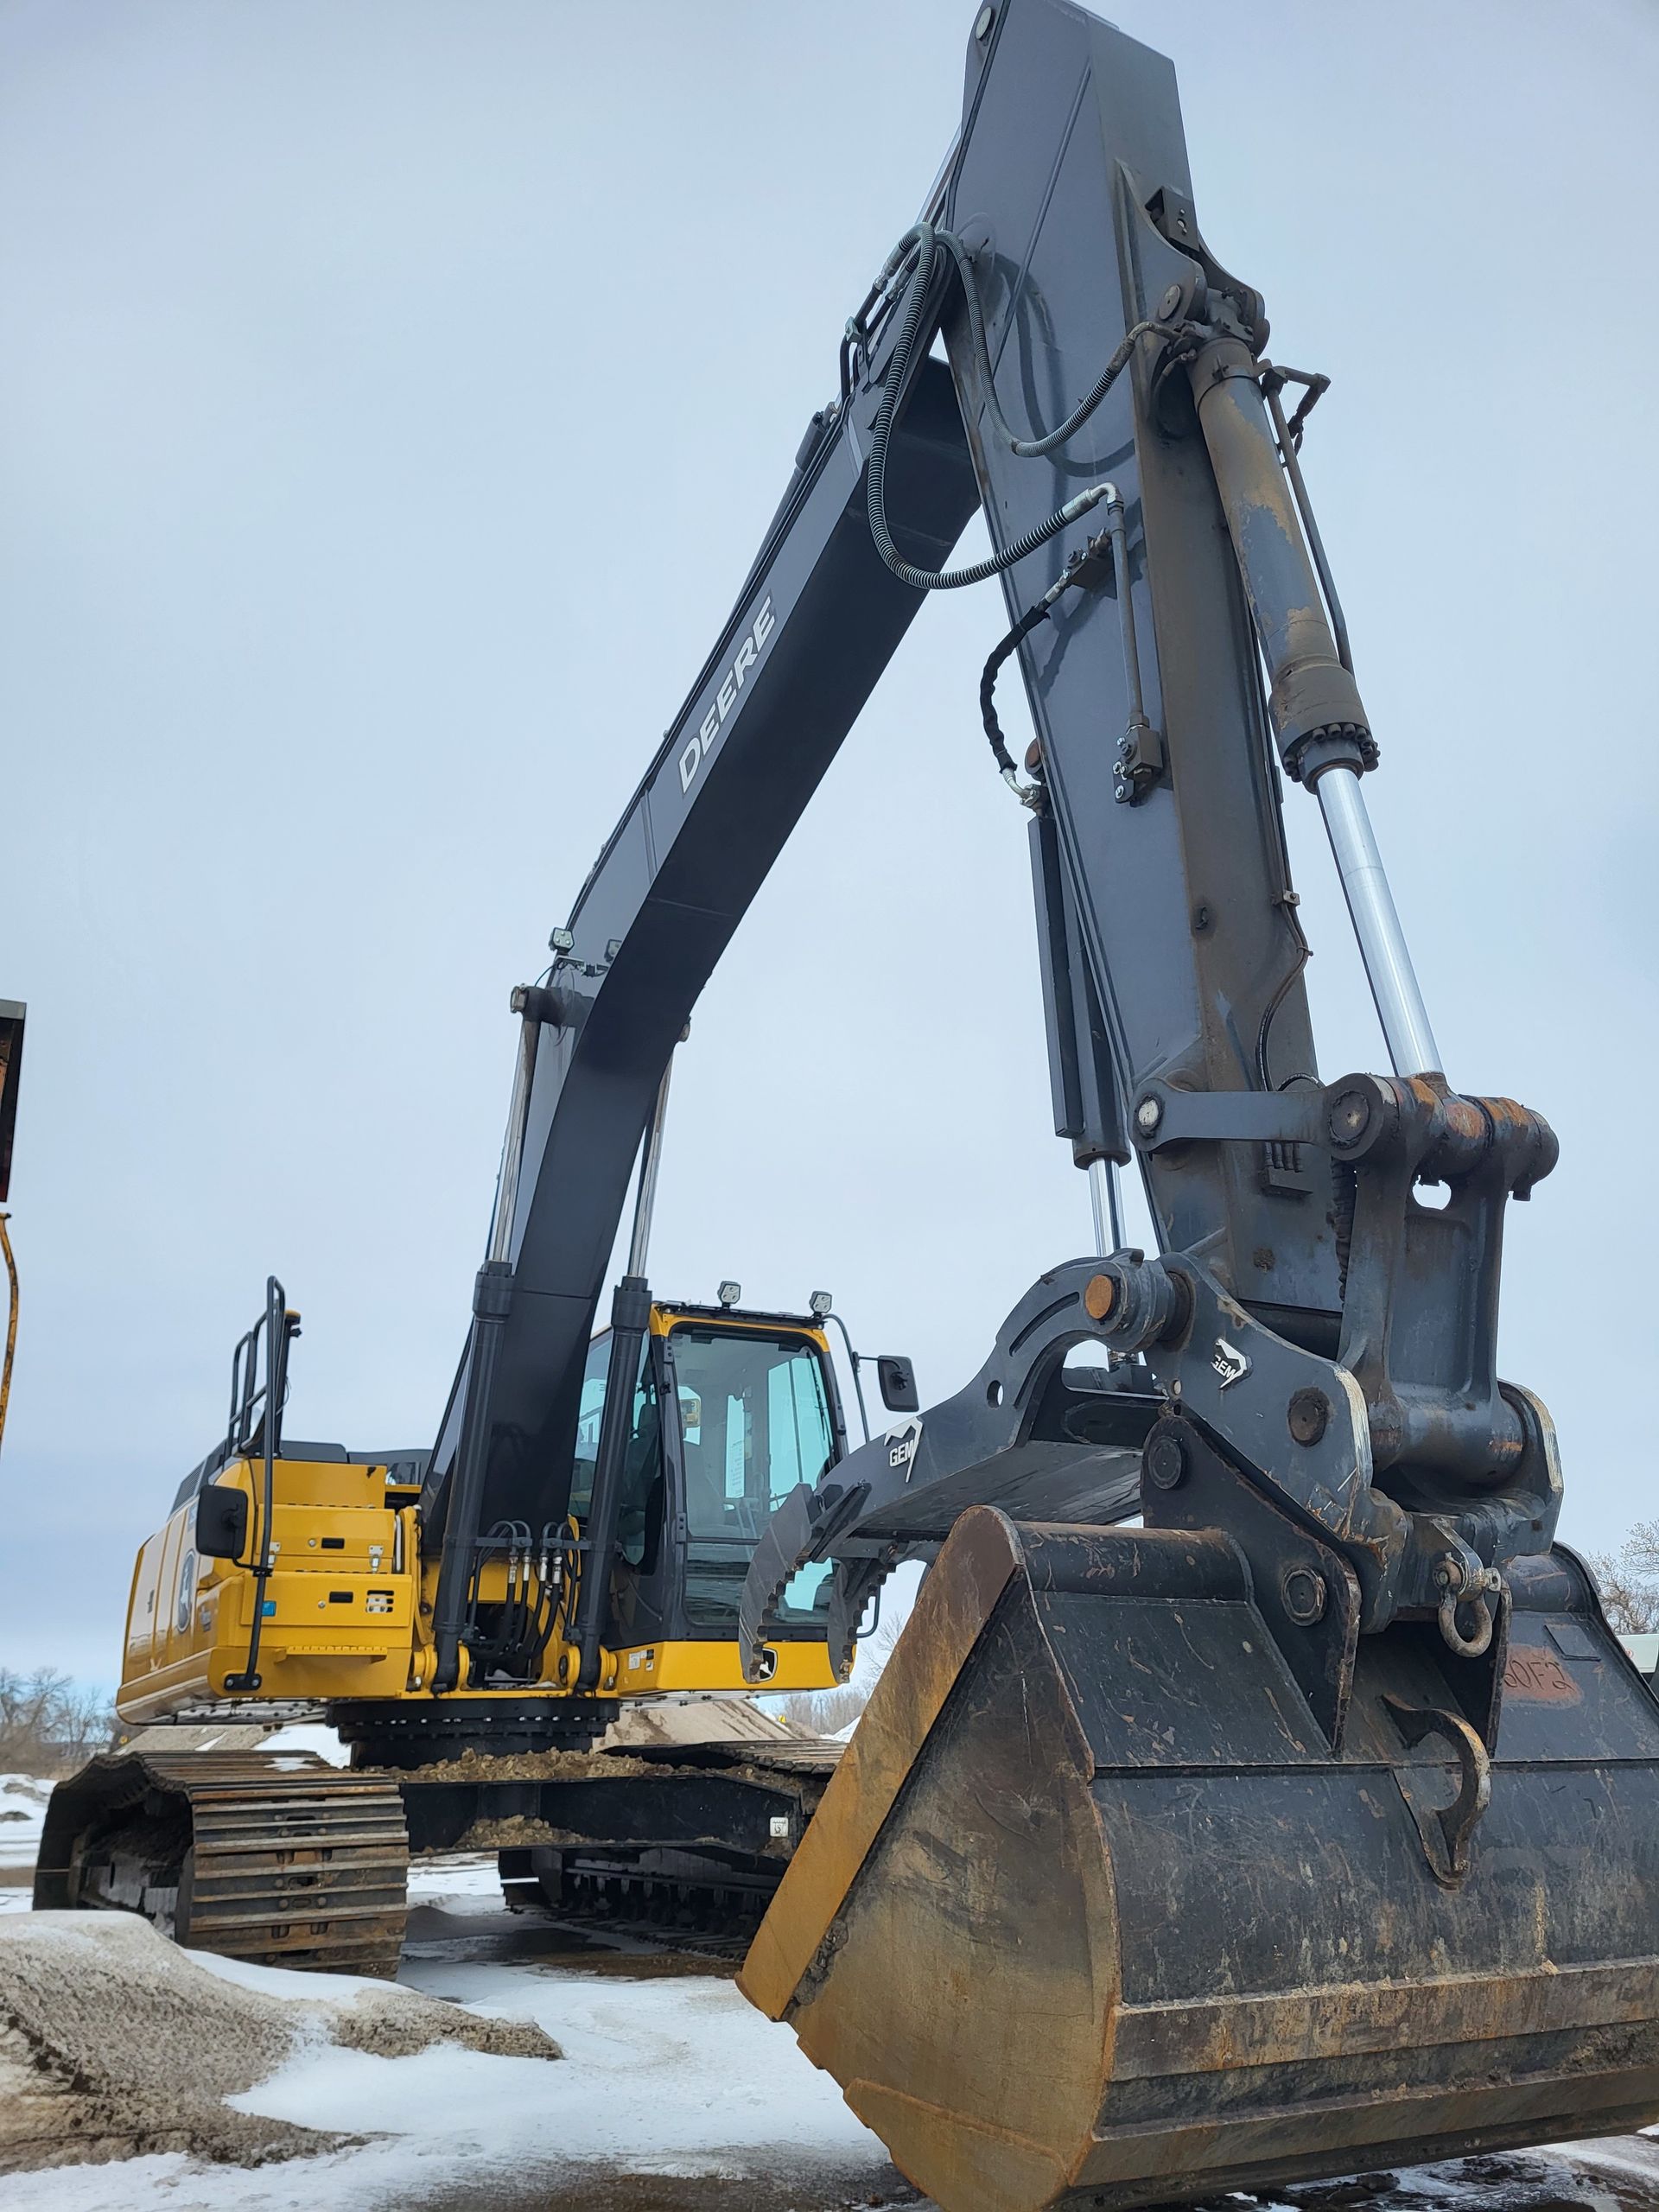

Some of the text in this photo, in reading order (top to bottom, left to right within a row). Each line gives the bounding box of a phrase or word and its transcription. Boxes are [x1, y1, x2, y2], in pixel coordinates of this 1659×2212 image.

[678, 596, 775, 794] DEERE
[1210, 1354, 1237, 1378] GEM
[889, 1439, 917, 1467] GEM
